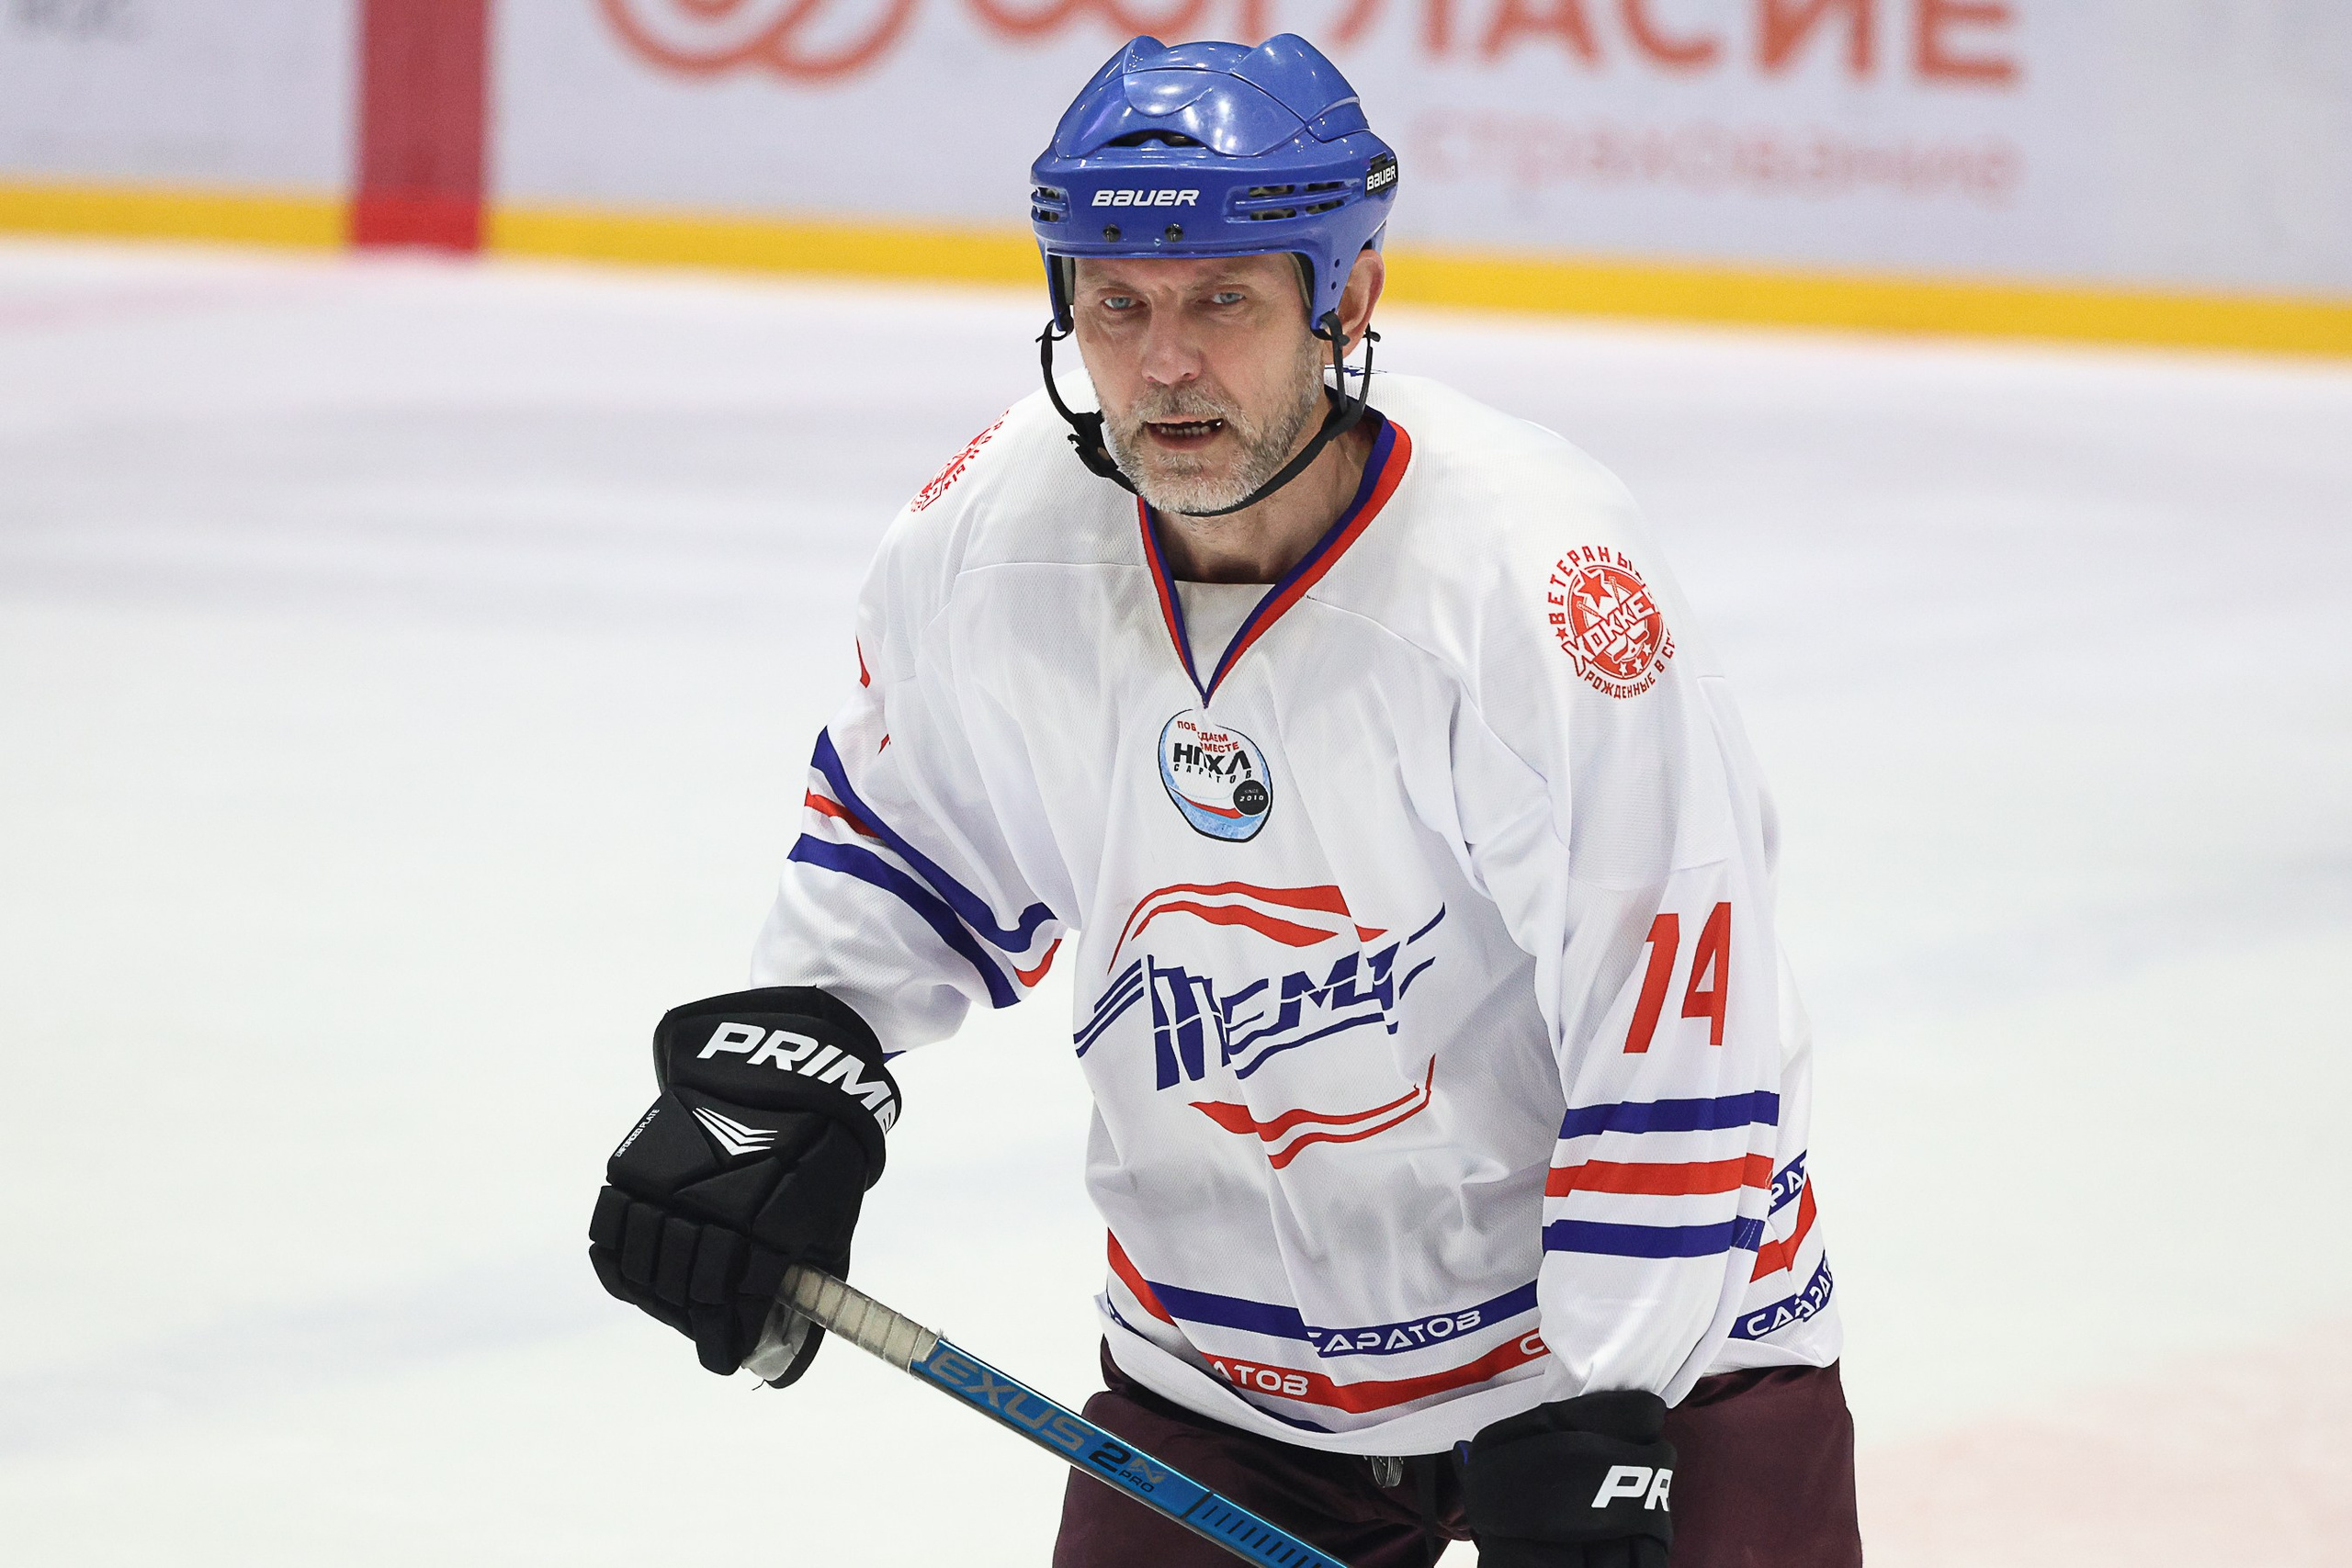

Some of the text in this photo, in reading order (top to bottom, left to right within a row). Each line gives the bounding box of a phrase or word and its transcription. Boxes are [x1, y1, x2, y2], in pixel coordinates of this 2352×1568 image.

[1091, 189, 1199, 207] BAUER
[1366, 164, 1396, 191] BAUER
[1561, 584, 1660, 676] ХОККЕ
[1585, 671, 1656, 700] РОЖДЕННЫЕ
[1654, 660, 1665, 673] В
[1623, 901, 1731, 1054] 14
[696, 1021, 897, 1134] PRIME
[928, 1347, 1095, 1452] EXUS
[1117, 1470, 1155, 1493] PRO
